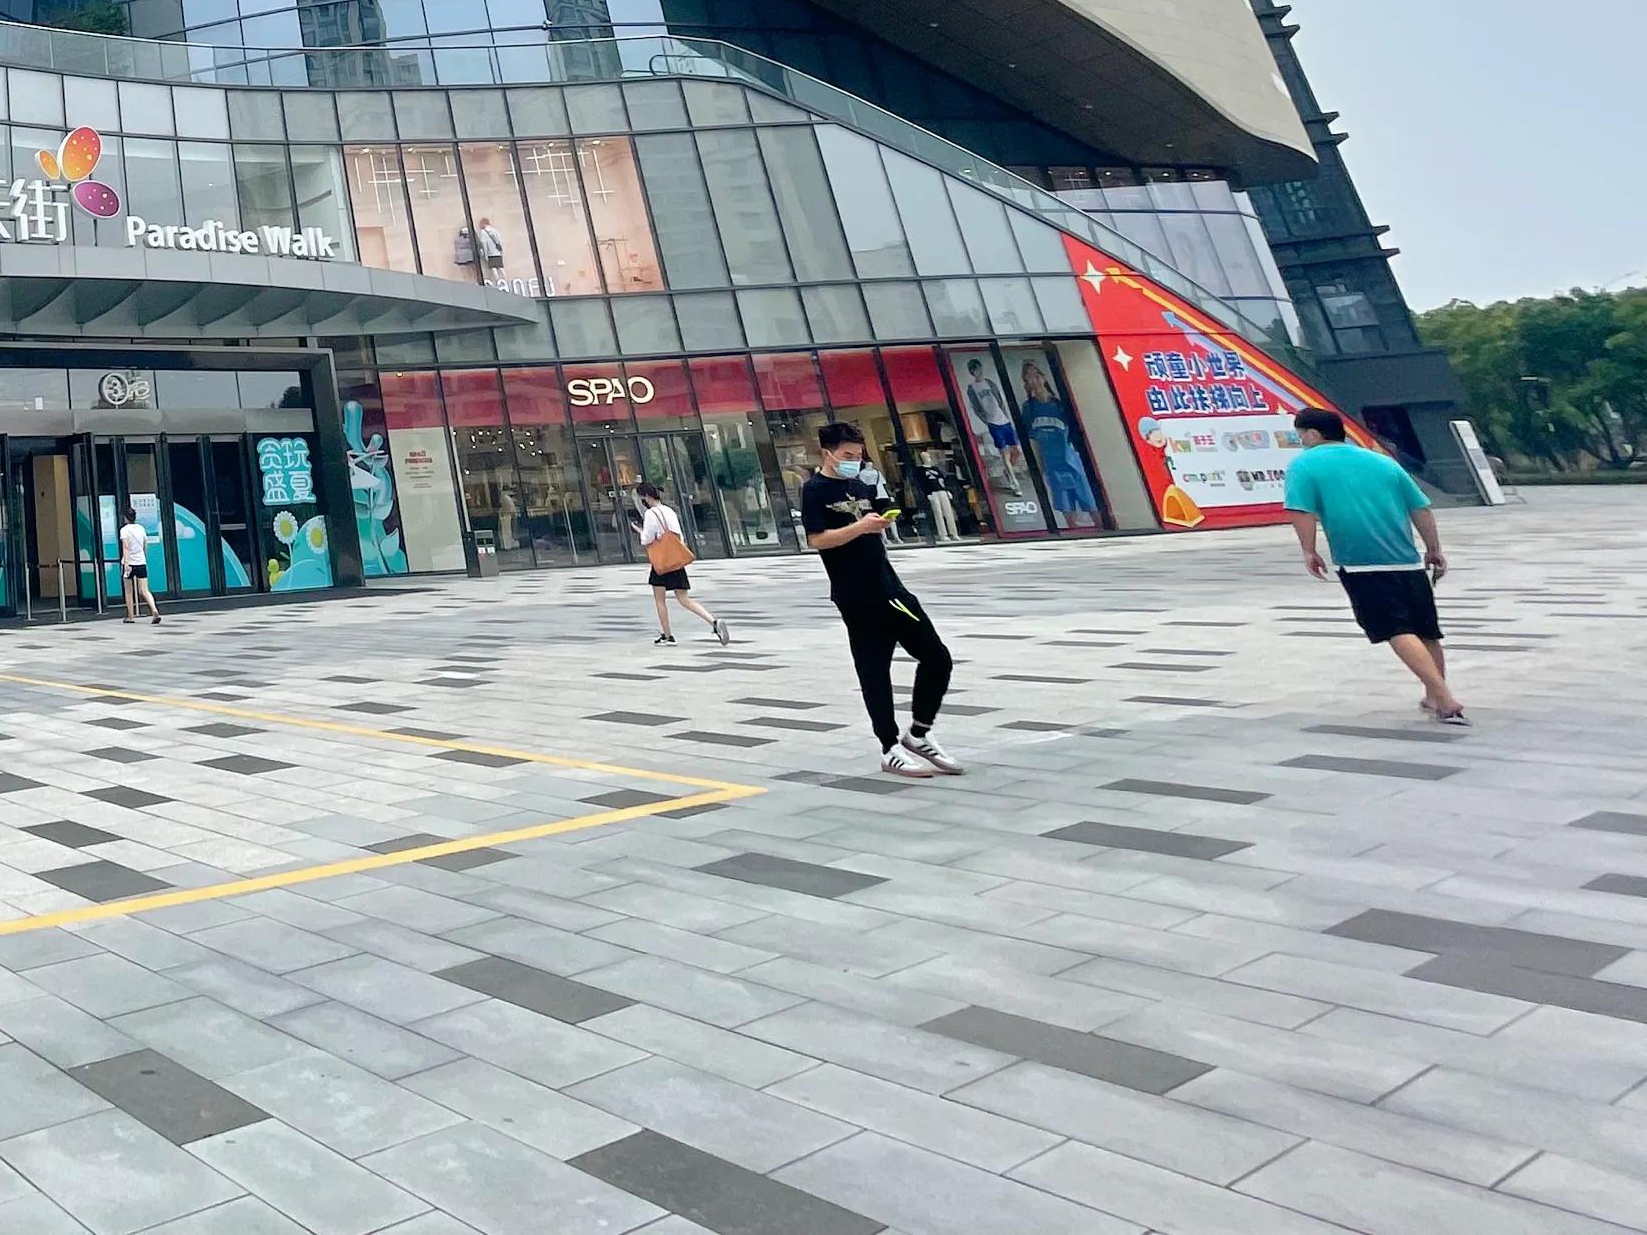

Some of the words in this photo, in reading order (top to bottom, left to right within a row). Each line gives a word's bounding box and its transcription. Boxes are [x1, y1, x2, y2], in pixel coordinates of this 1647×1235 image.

[126, 215, 259, 254] Paradise
[257, 225, 336, 259] Walk
[1144, 350, 1247, 382] 顽童小世界
[567, 376, 655, 406] SPAO
[257, 438, 311, 469] 贪玩
[264, 469, 317, 503] 盛夏
[1005, 501, 1038, 515] SPAO
